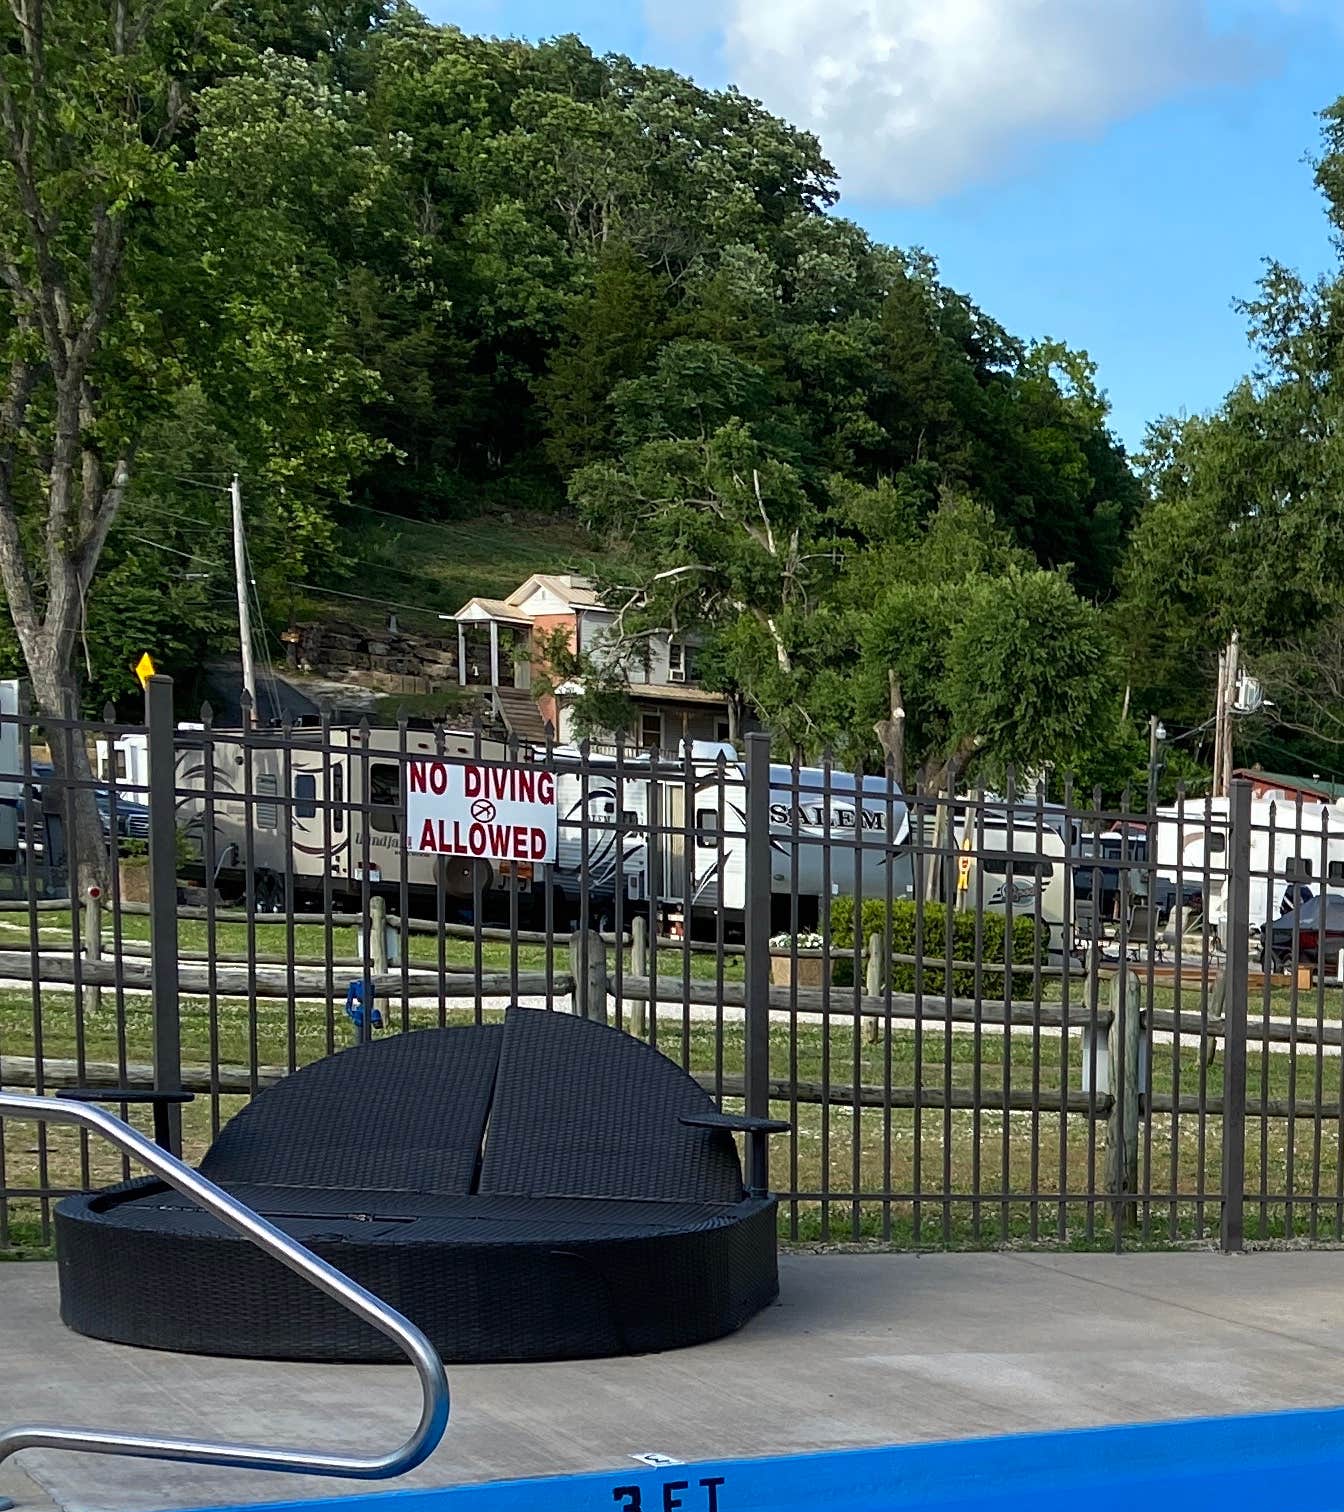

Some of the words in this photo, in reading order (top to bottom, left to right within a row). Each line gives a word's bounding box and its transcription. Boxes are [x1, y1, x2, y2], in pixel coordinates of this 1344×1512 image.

[410, 761, 447, 795] NO
[465, 765, 554, 805] DIVING
[420, 819, 547, 860] ALLOWED
